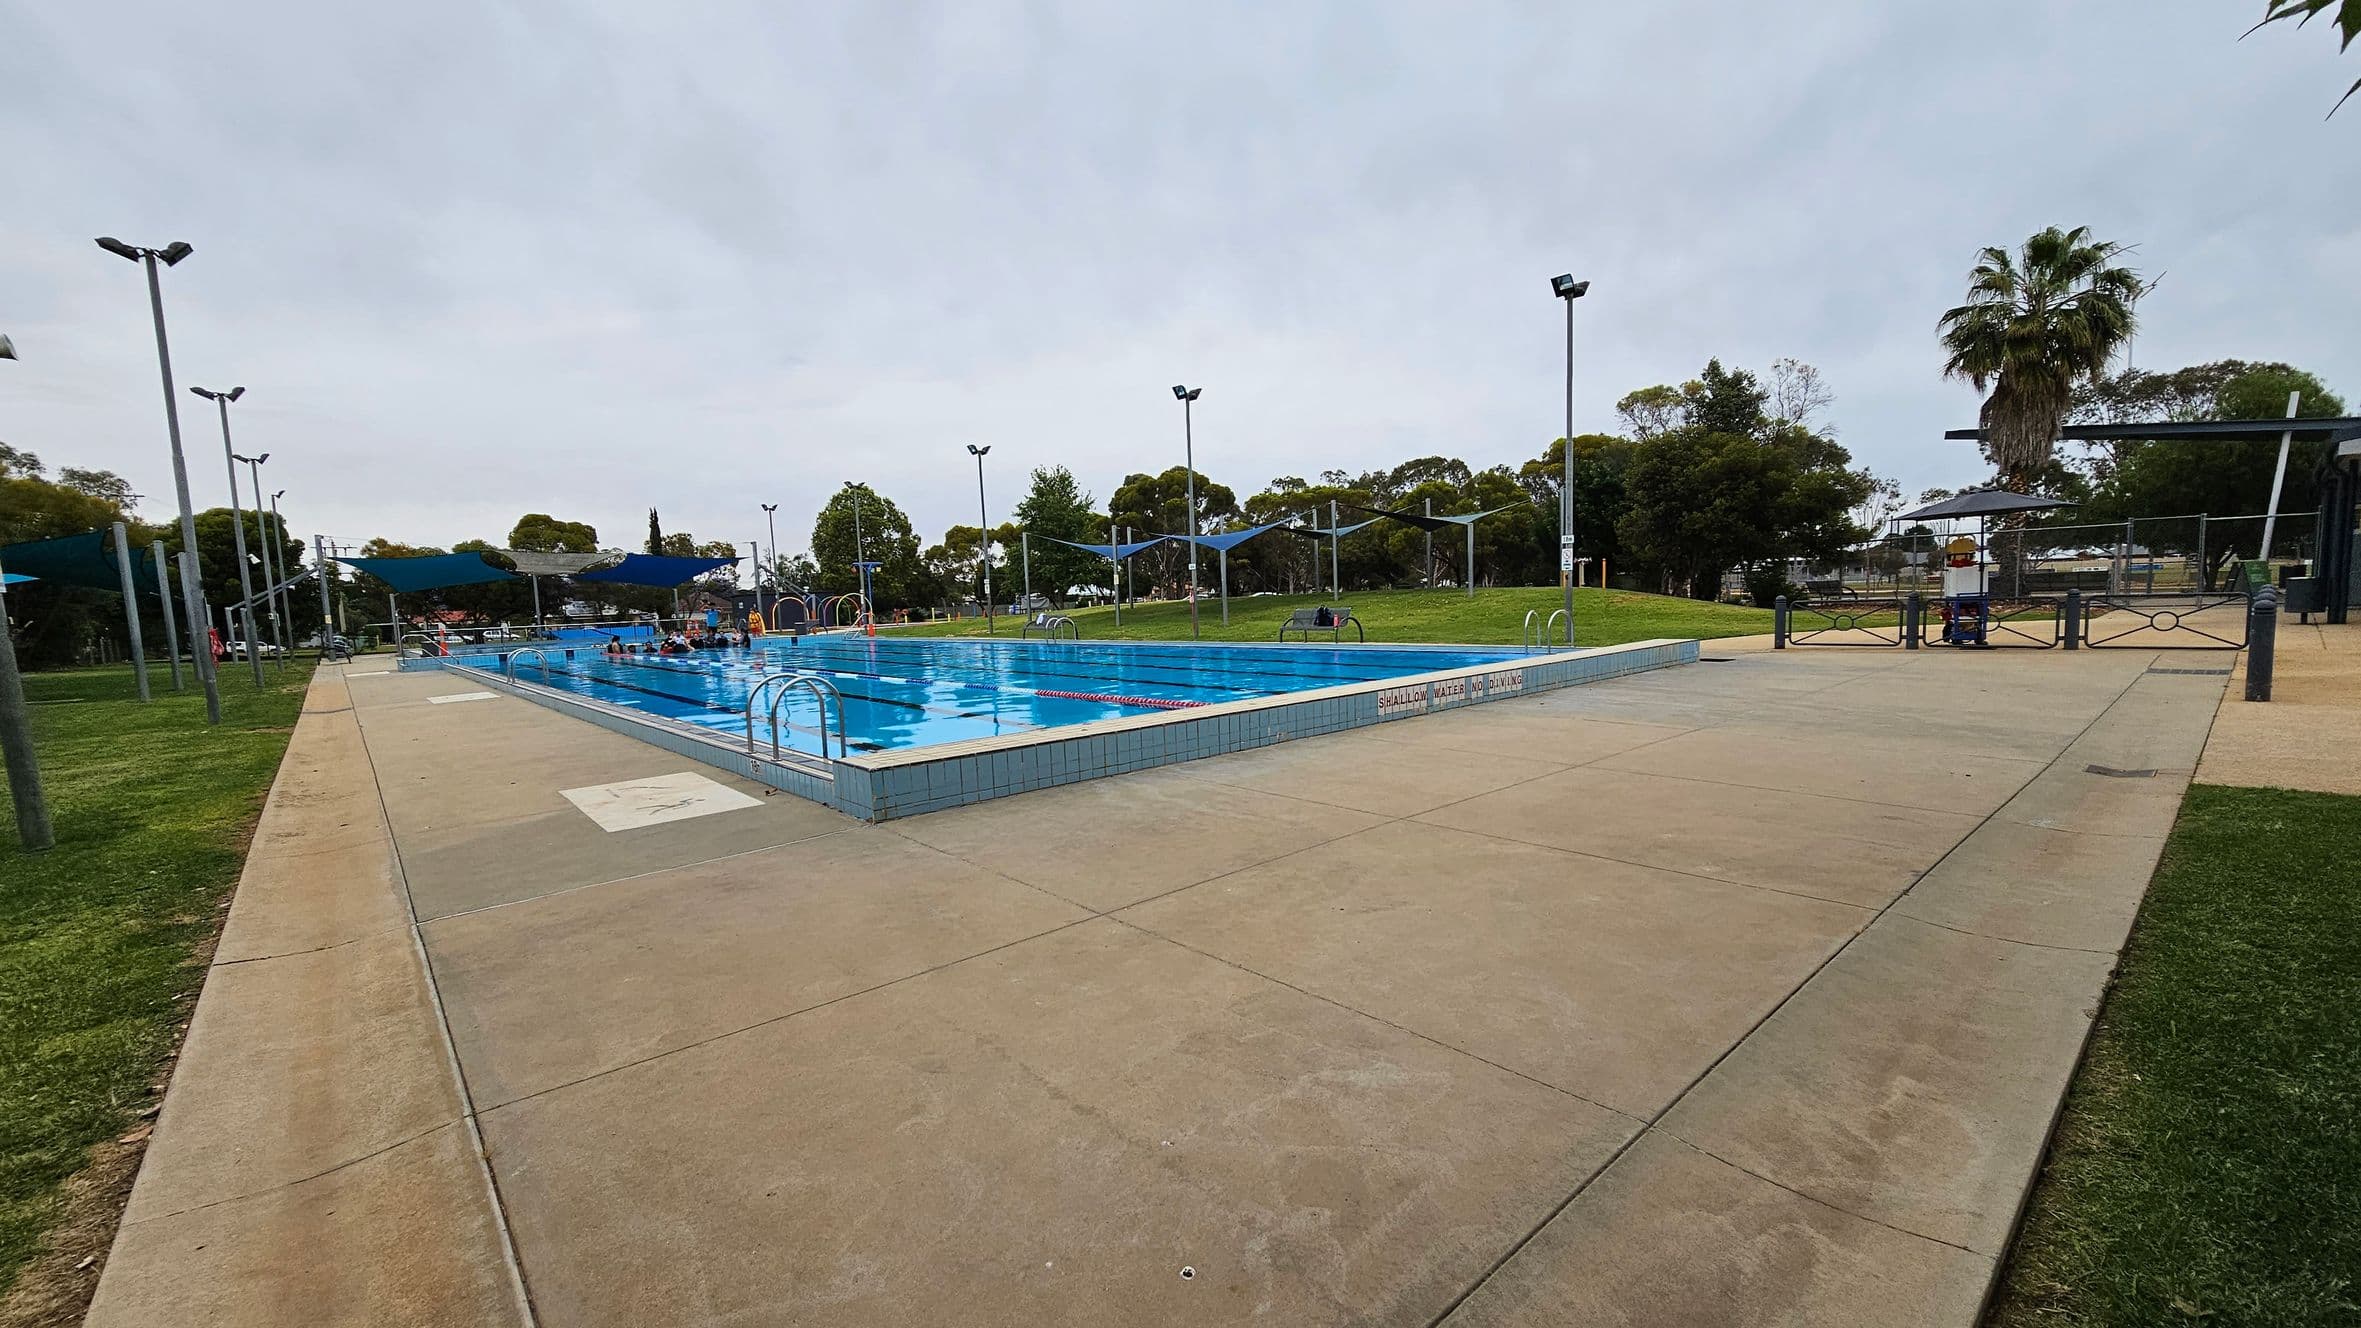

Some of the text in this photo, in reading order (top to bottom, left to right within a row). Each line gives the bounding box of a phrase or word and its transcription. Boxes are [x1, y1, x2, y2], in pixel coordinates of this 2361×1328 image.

[1378, 674, 1523, 709] SHALLOW WATER NO DIVING
